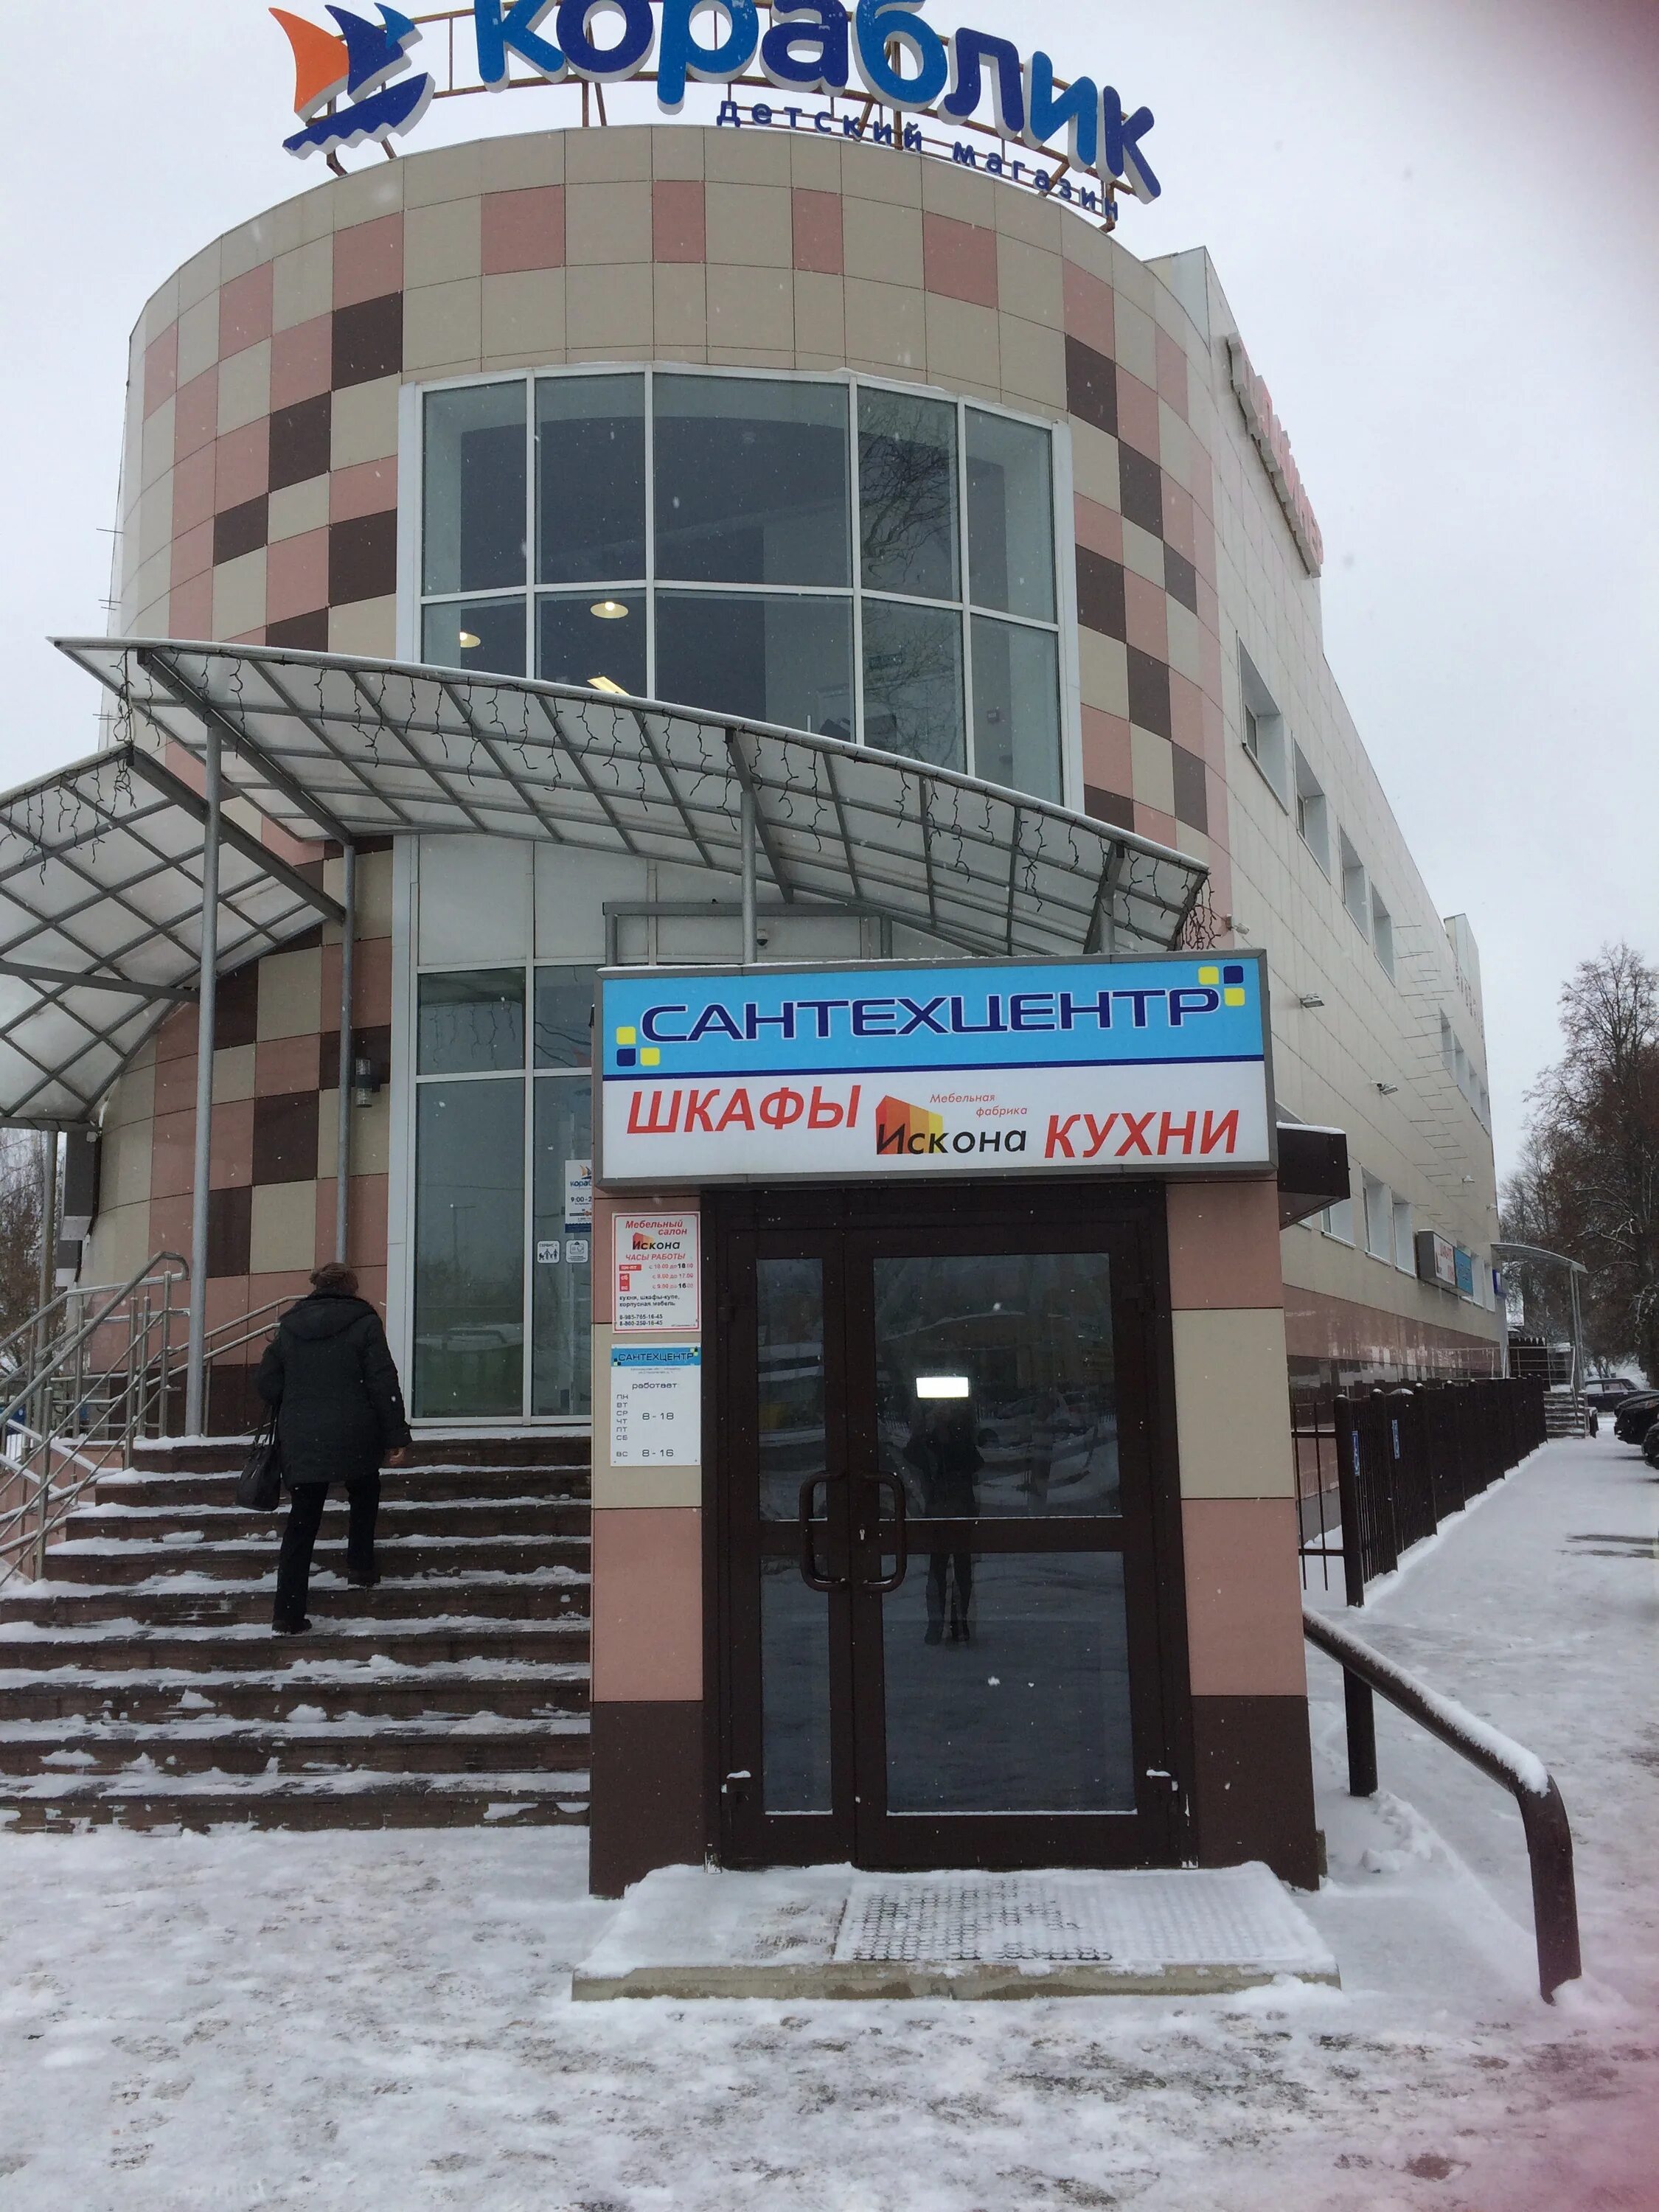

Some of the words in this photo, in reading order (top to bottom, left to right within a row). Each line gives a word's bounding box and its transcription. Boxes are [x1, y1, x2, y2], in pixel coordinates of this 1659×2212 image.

[716, 100, 924, 153] детский
[951, 139, 1119, 222] магазин
[641, 987, 1221, 1043] САНТЕХЦЕНТР
[929, 1092, 996, 1104] Мебельная
[626, 1085, 862, 1135] ШКАФЫ
[975, 1105, 1028, 1118] фабрика
[1044, 1109, 1239, 1159] КУХНИ
[876, 1128, 1027, 1156] Искона
[625, 1220, 683, 1229] Мебельный
[633, 1240, 680, 1251] Искона
[618, 1353, 694, 1362] САНТЕХЦЕНТР
[632, 1382, 678, 1391] работает
